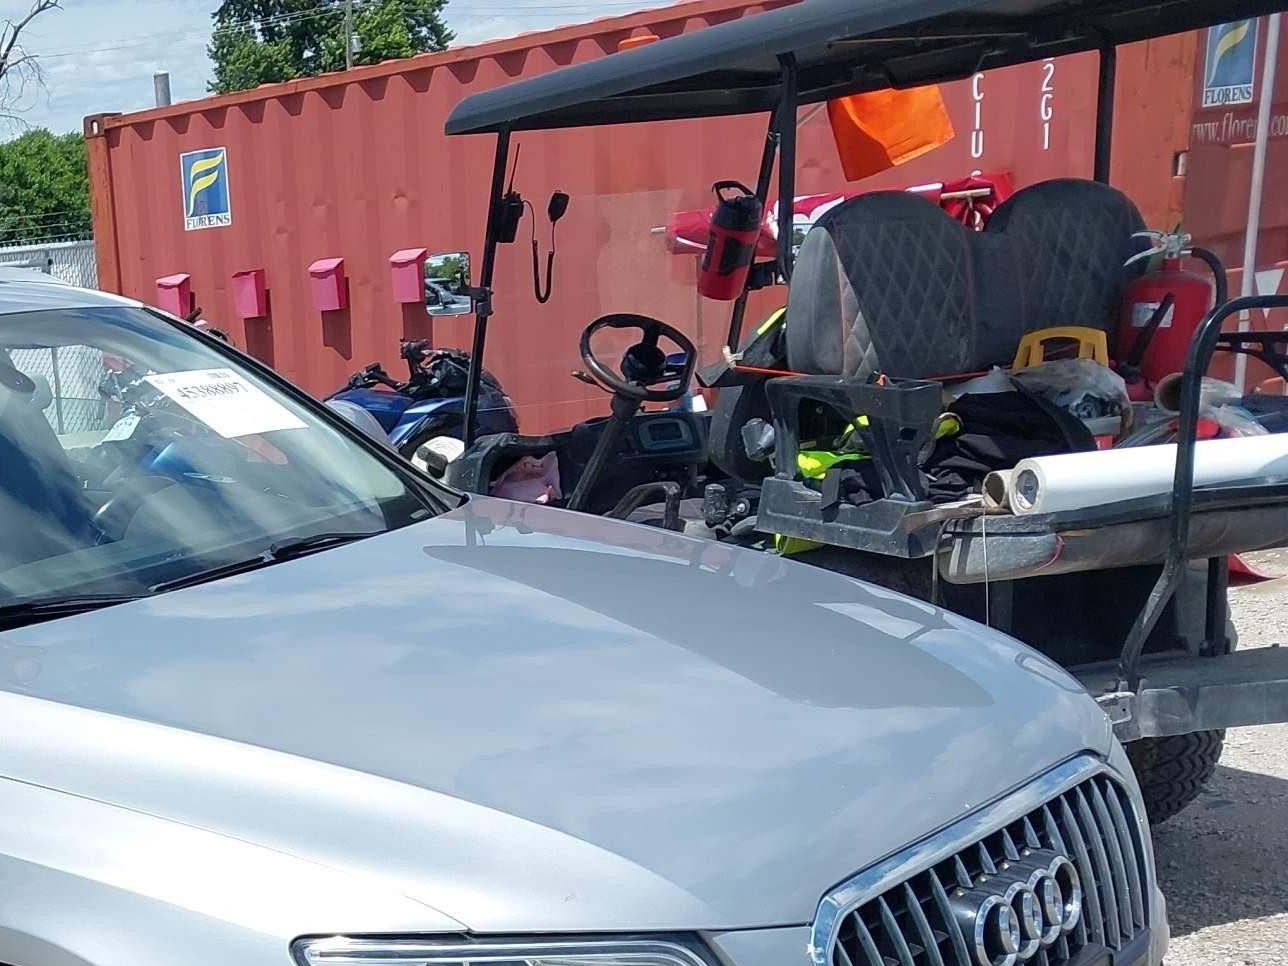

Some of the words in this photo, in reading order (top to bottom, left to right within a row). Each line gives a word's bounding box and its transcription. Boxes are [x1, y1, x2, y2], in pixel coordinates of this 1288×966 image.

[1040, 58, 1055, 150] 2G1
[1204, 86, 1252, 105] FLORENS
[176, 381, 250, 400] 45388897
